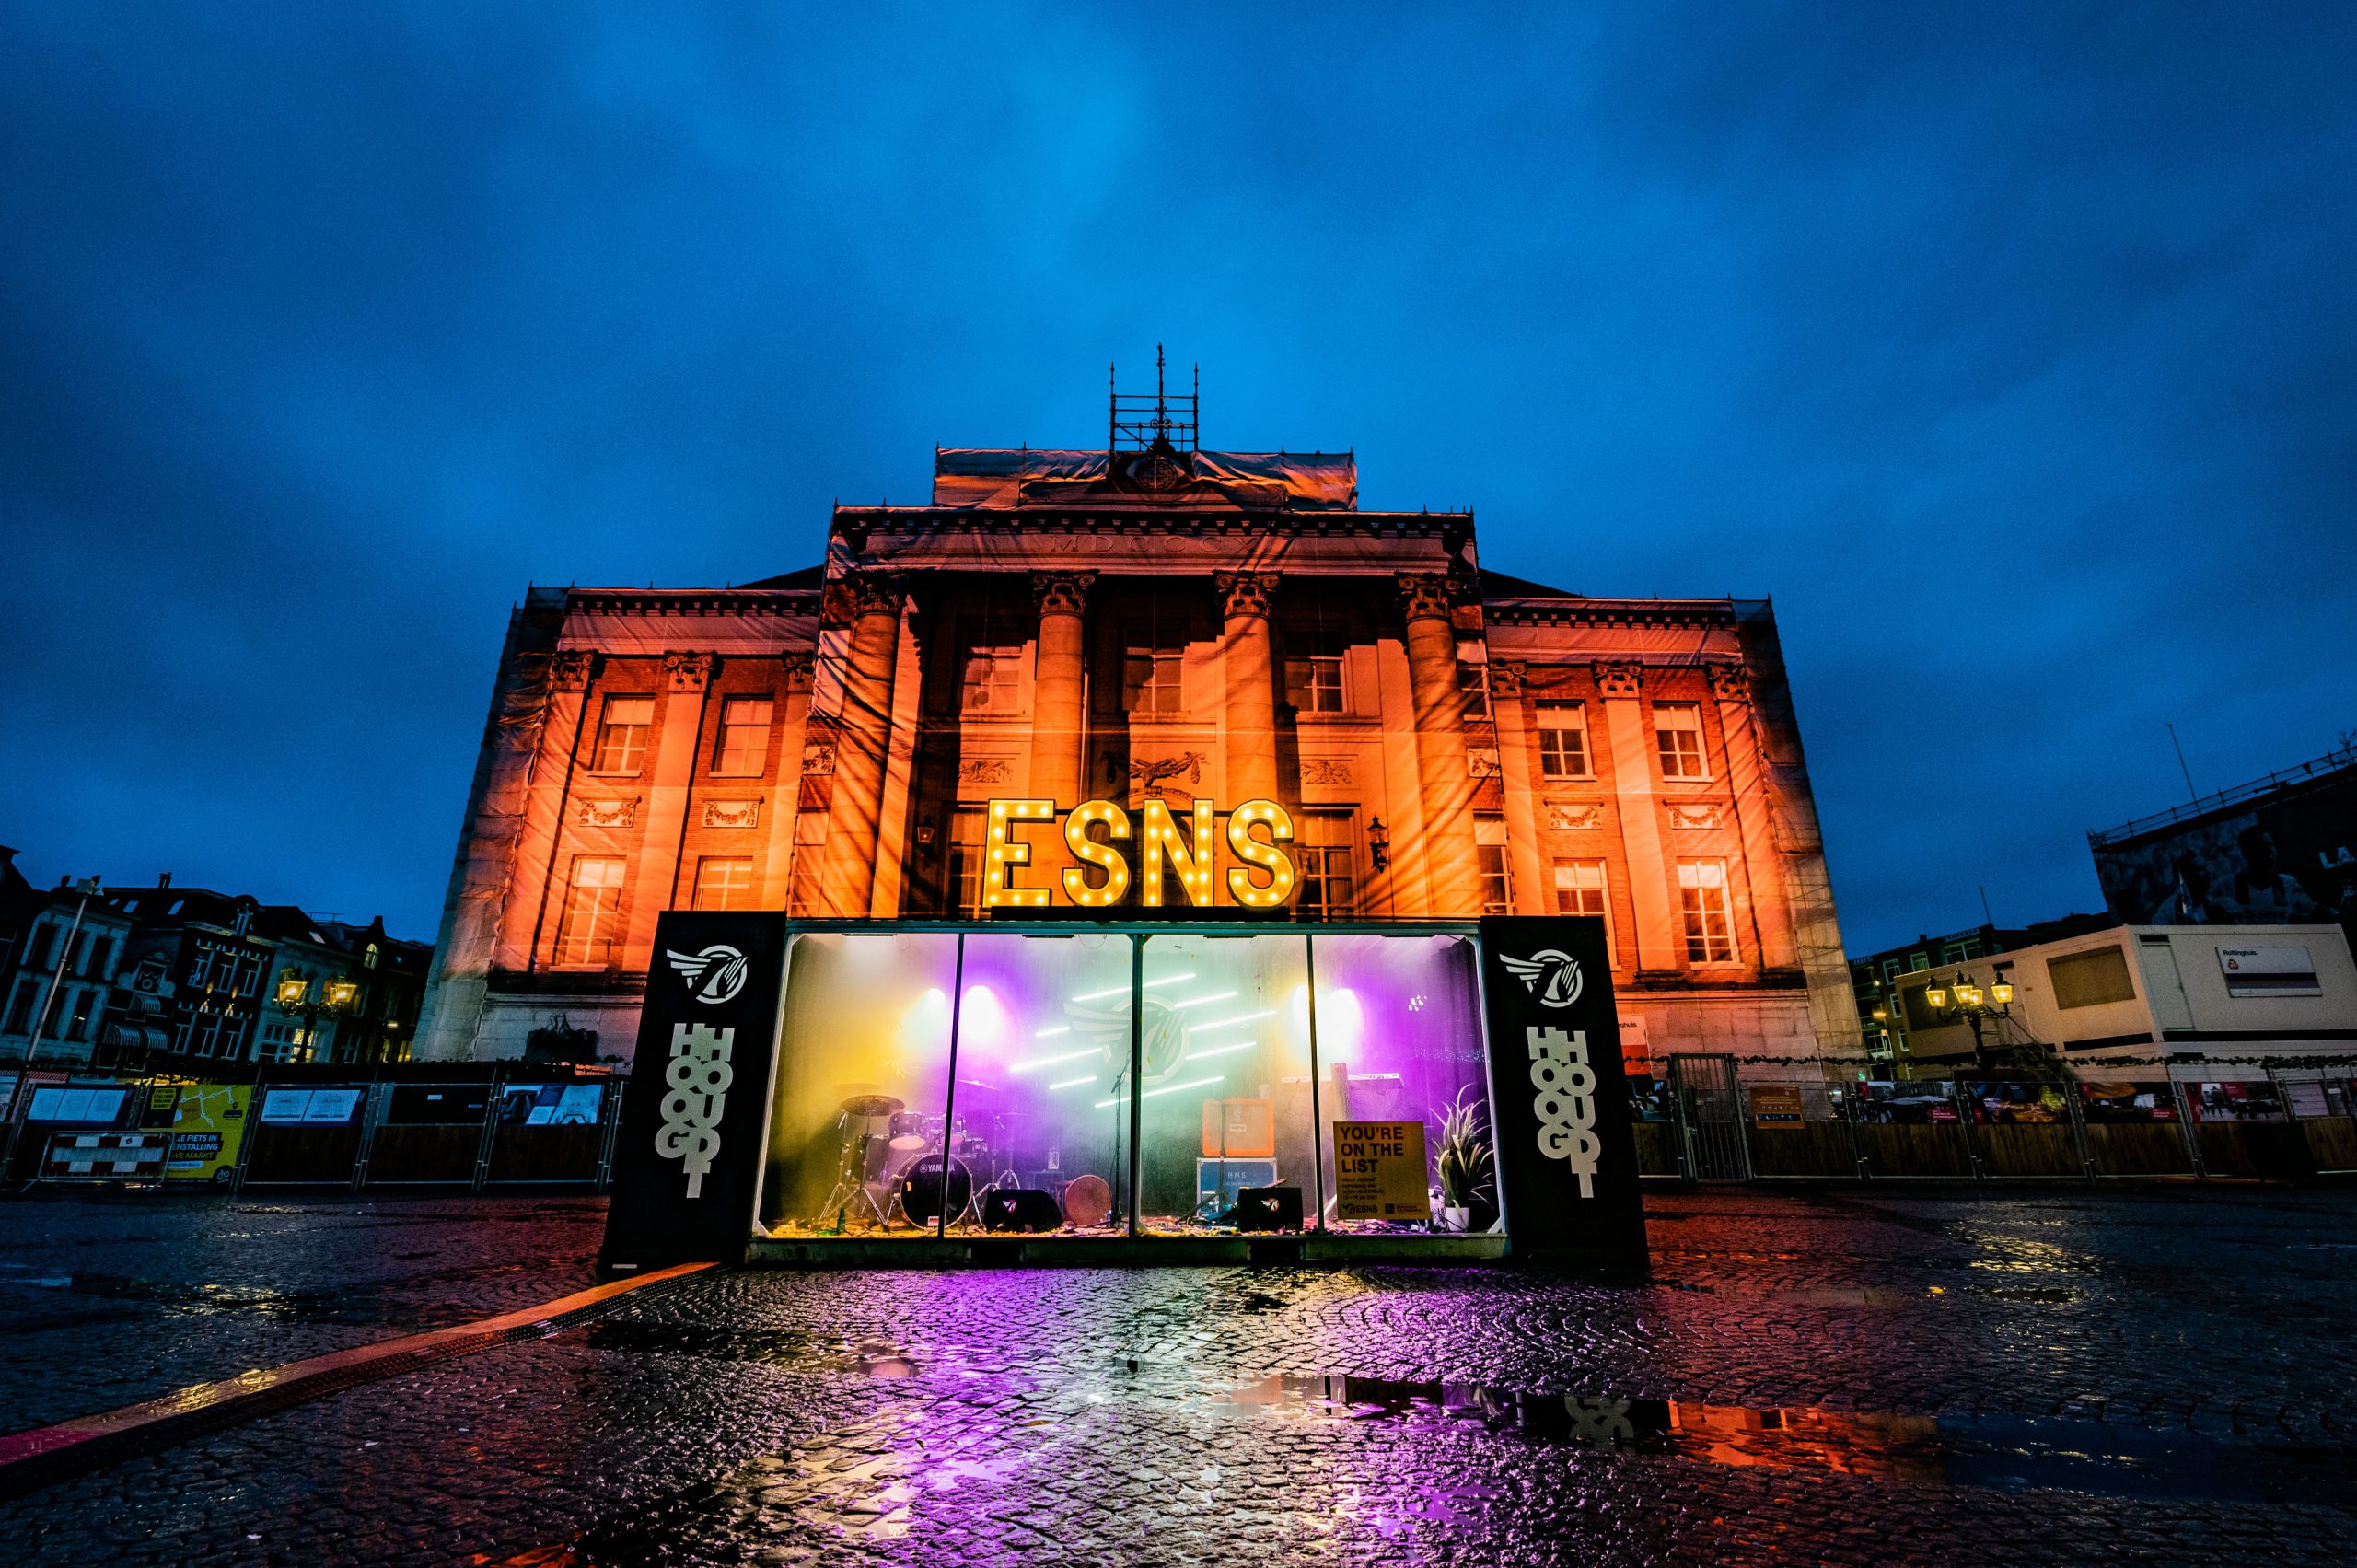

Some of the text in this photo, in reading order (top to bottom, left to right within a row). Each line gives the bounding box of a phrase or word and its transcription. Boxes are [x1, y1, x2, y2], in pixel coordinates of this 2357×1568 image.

[981, 798, 1295, 907] ESNS
[1340, 1126, 1404, 1140] YOU'RE
[172, 1143, 219, 1151] ENSTALLING
[1341, 1143, 1404, 1156] ON THE
[185, 1151, 214, 1159] MARKT
[1341, 1159, 1379, 1173] LIST
